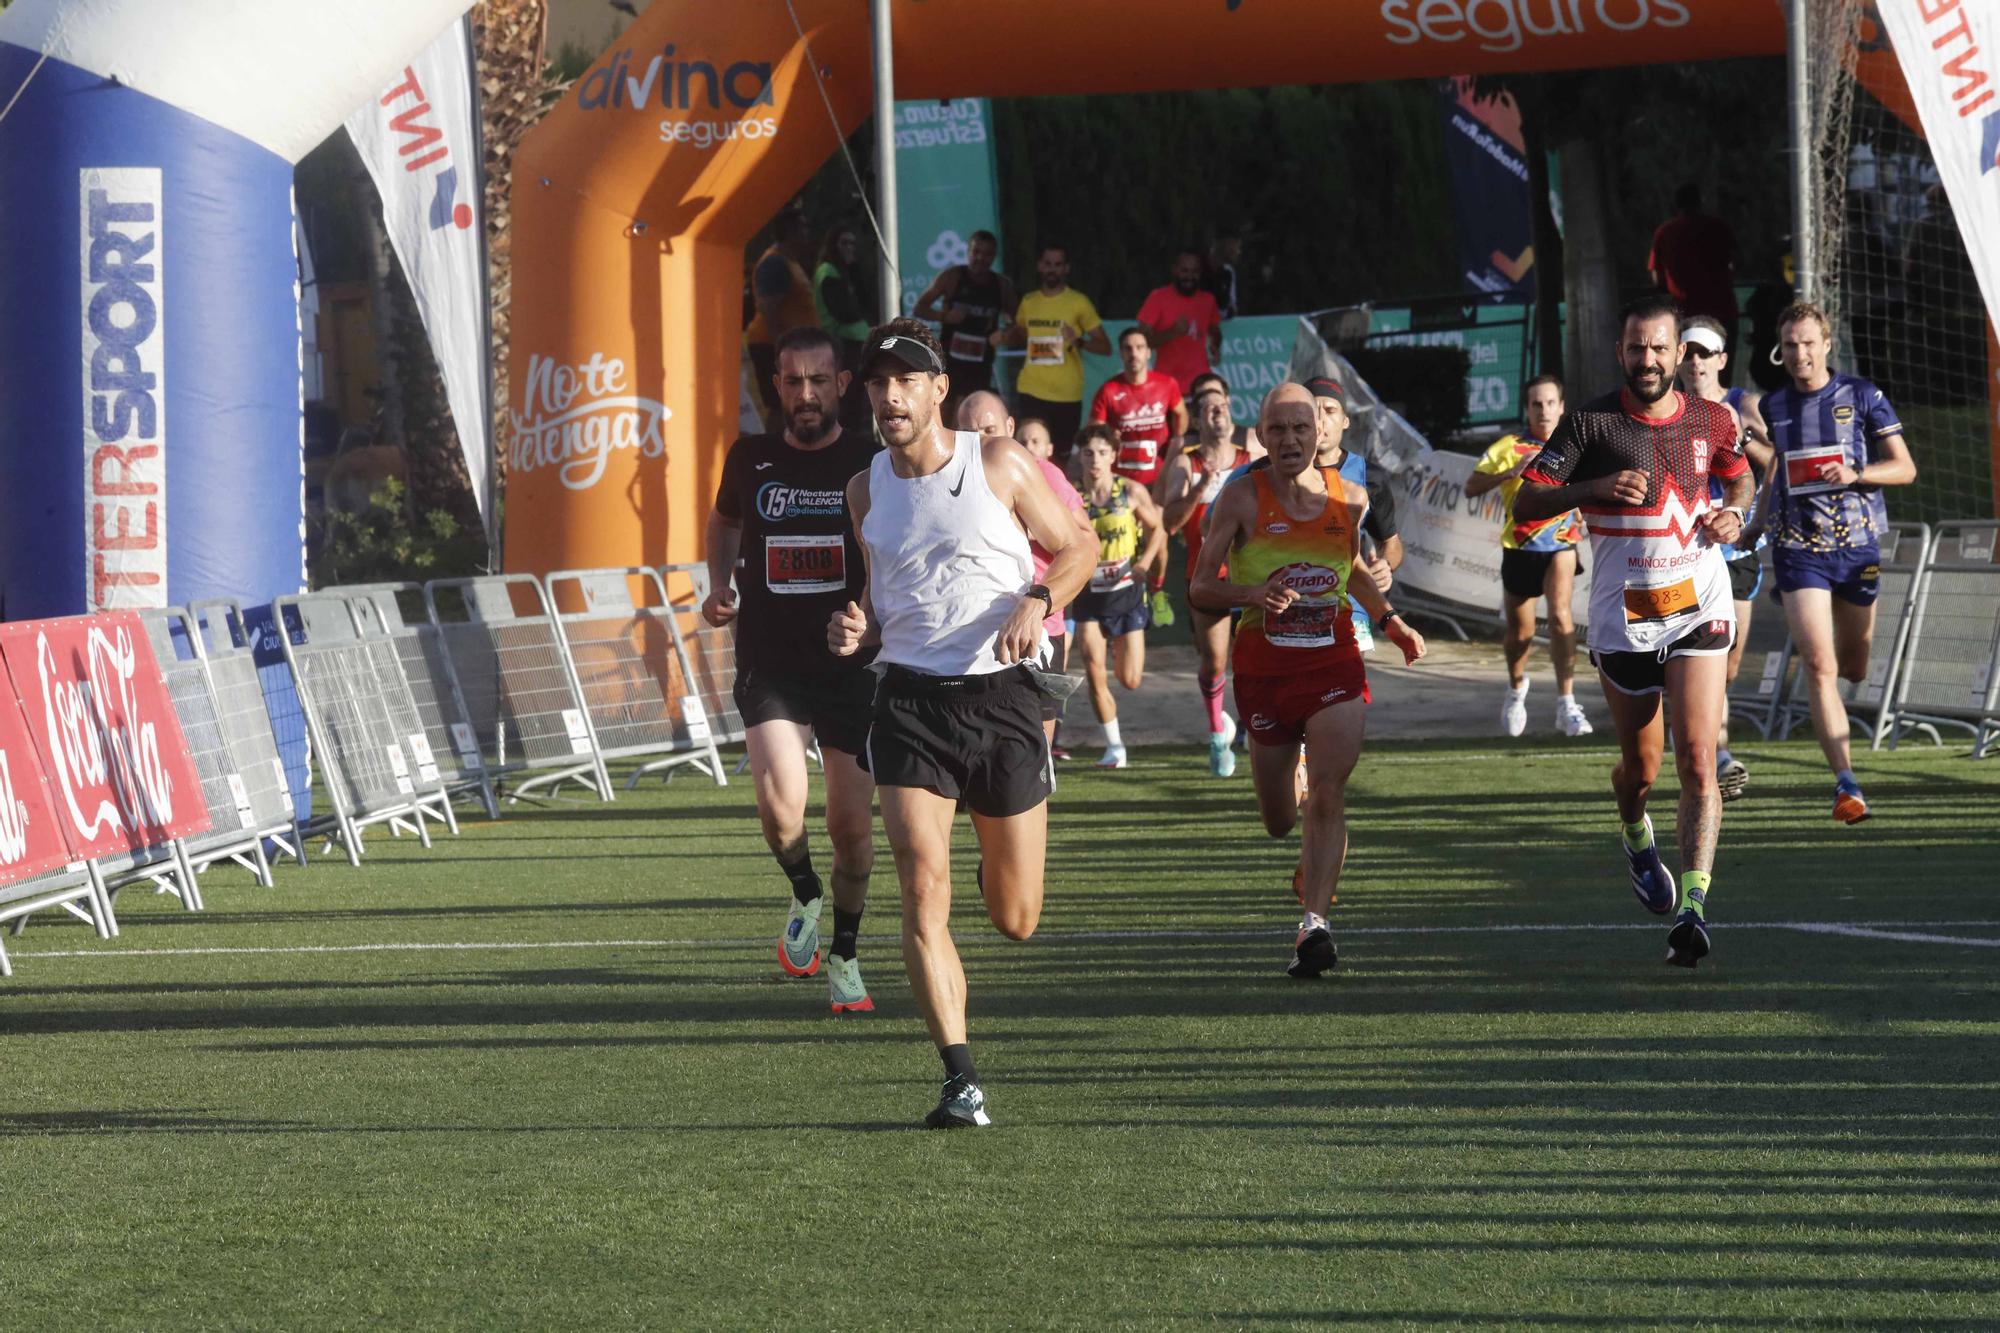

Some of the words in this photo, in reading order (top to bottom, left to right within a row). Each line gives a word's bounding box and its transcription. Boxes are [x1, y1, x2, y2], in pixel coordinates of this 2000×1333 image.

[1381, 0, 1690, 51] seguros
[577, 43, 775, 111] divina
[659, 117, 778, 149] seguros
[88, 188, 161, 607] TERSPORT
[524, 353, 583, 421] No
[579, 352, 628, 397] te
[507, 395, 673, 491] detengas
[799, 489, 844, 498] Nocturna
[799, 497, 843, 506] VALENCIA
[1628, 553, 1668, 569] MUÑOZ
[1670, 550, 1702, 567] BOSCH
[1281, 574, 1336, 588] errano
